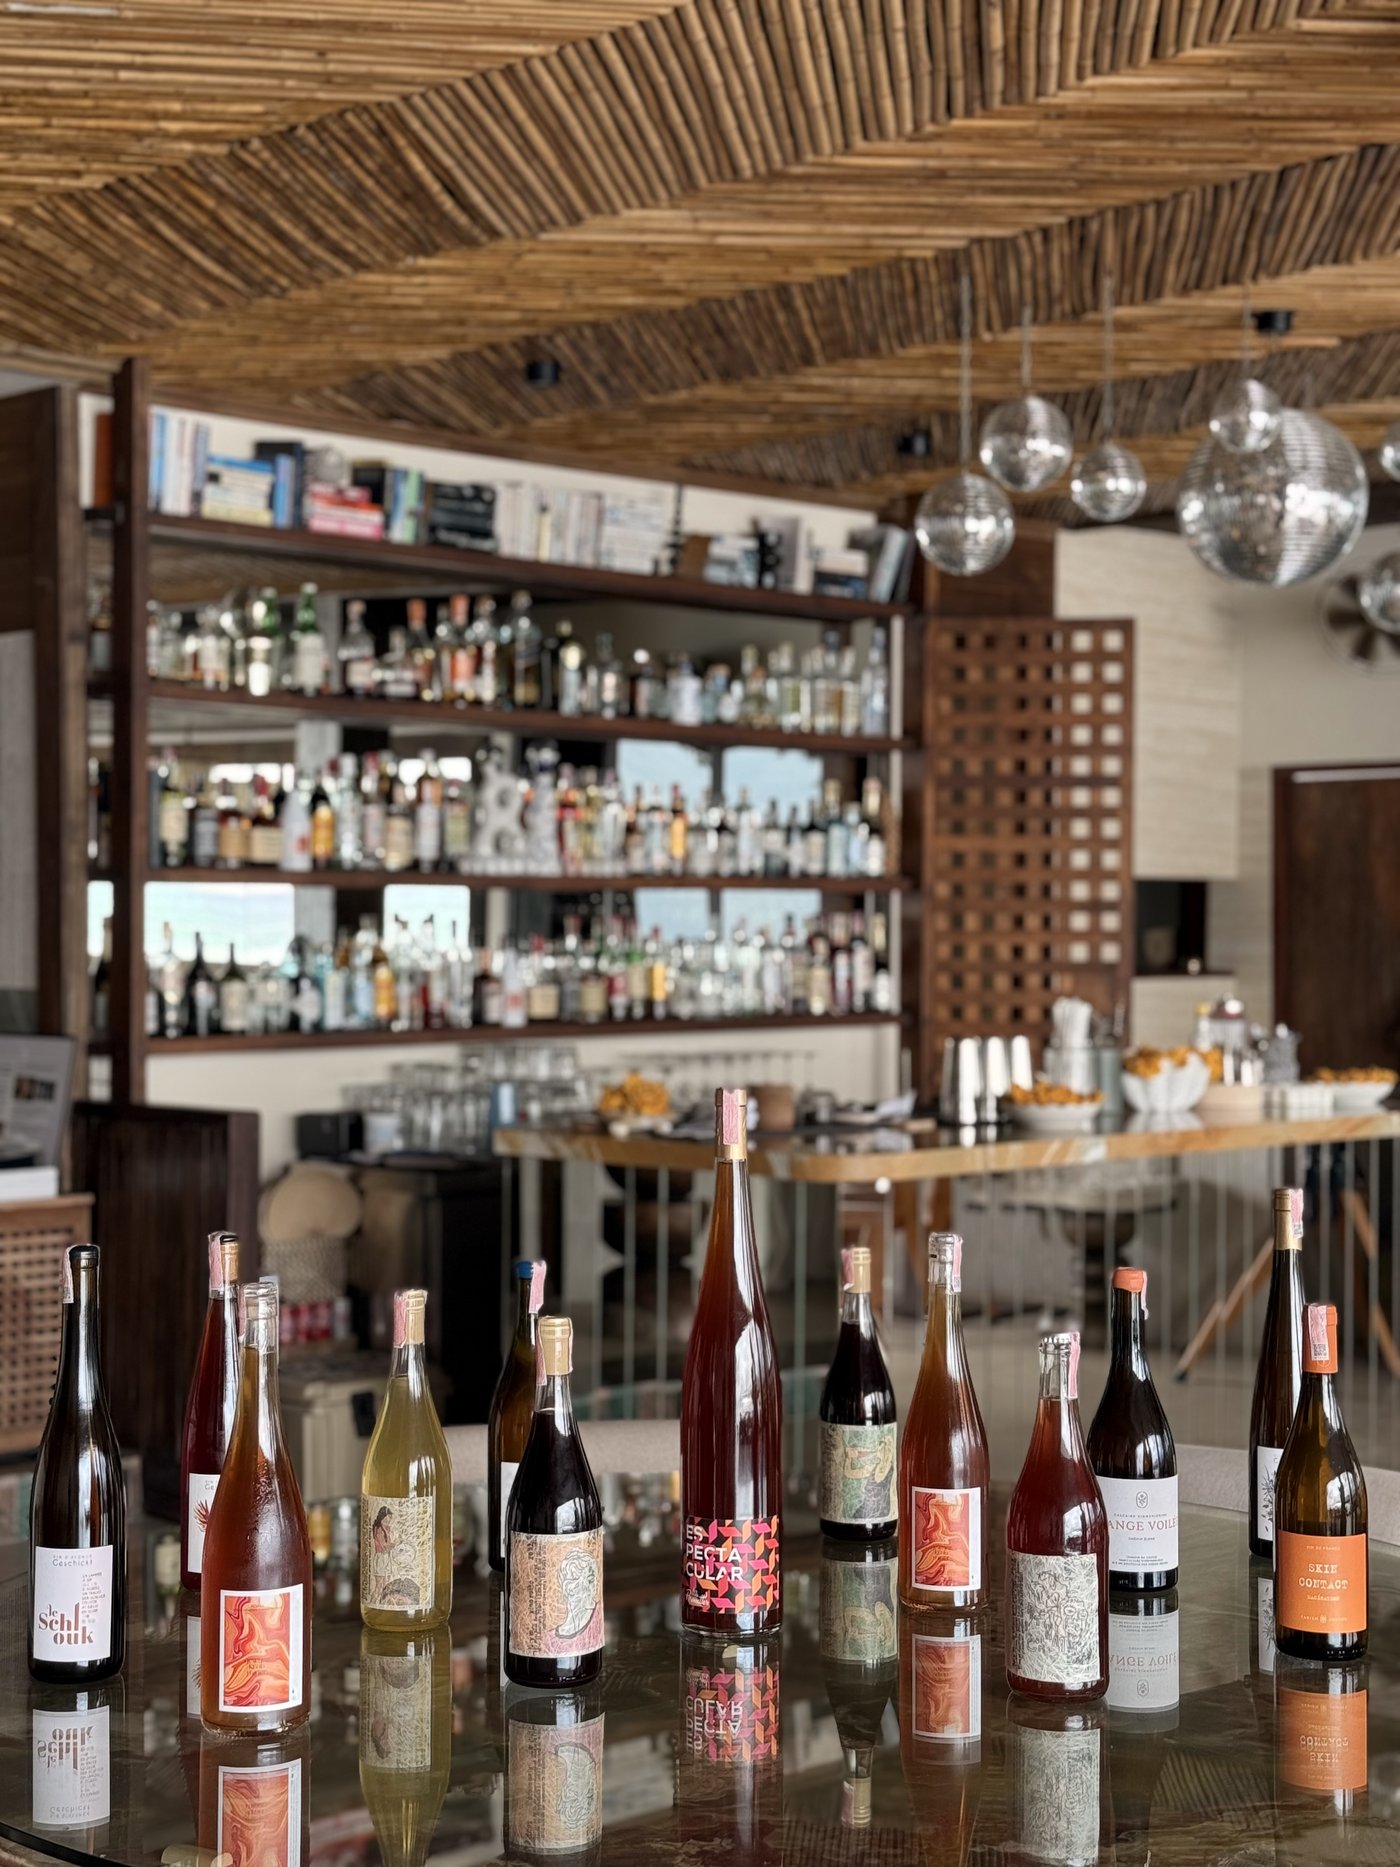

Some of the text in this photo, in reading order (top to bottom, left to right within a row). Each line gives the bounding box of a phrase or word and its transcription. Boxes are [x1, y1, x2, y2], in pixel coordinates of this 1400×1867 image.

[686, 1524, 703, 1542] ES
[686, 1544, 742, 1563] PECTA
[686, 1562, 744, 1582] CULAR
[1308, 1563, 1339, 1574] SKIN
[1298, 1577, 1349, 1590] CONTACT
[38, 1602, 80, 1632] Schl
[47, 1603, 58, 1617] le
[53, 1626, 94, 1645] ouk
